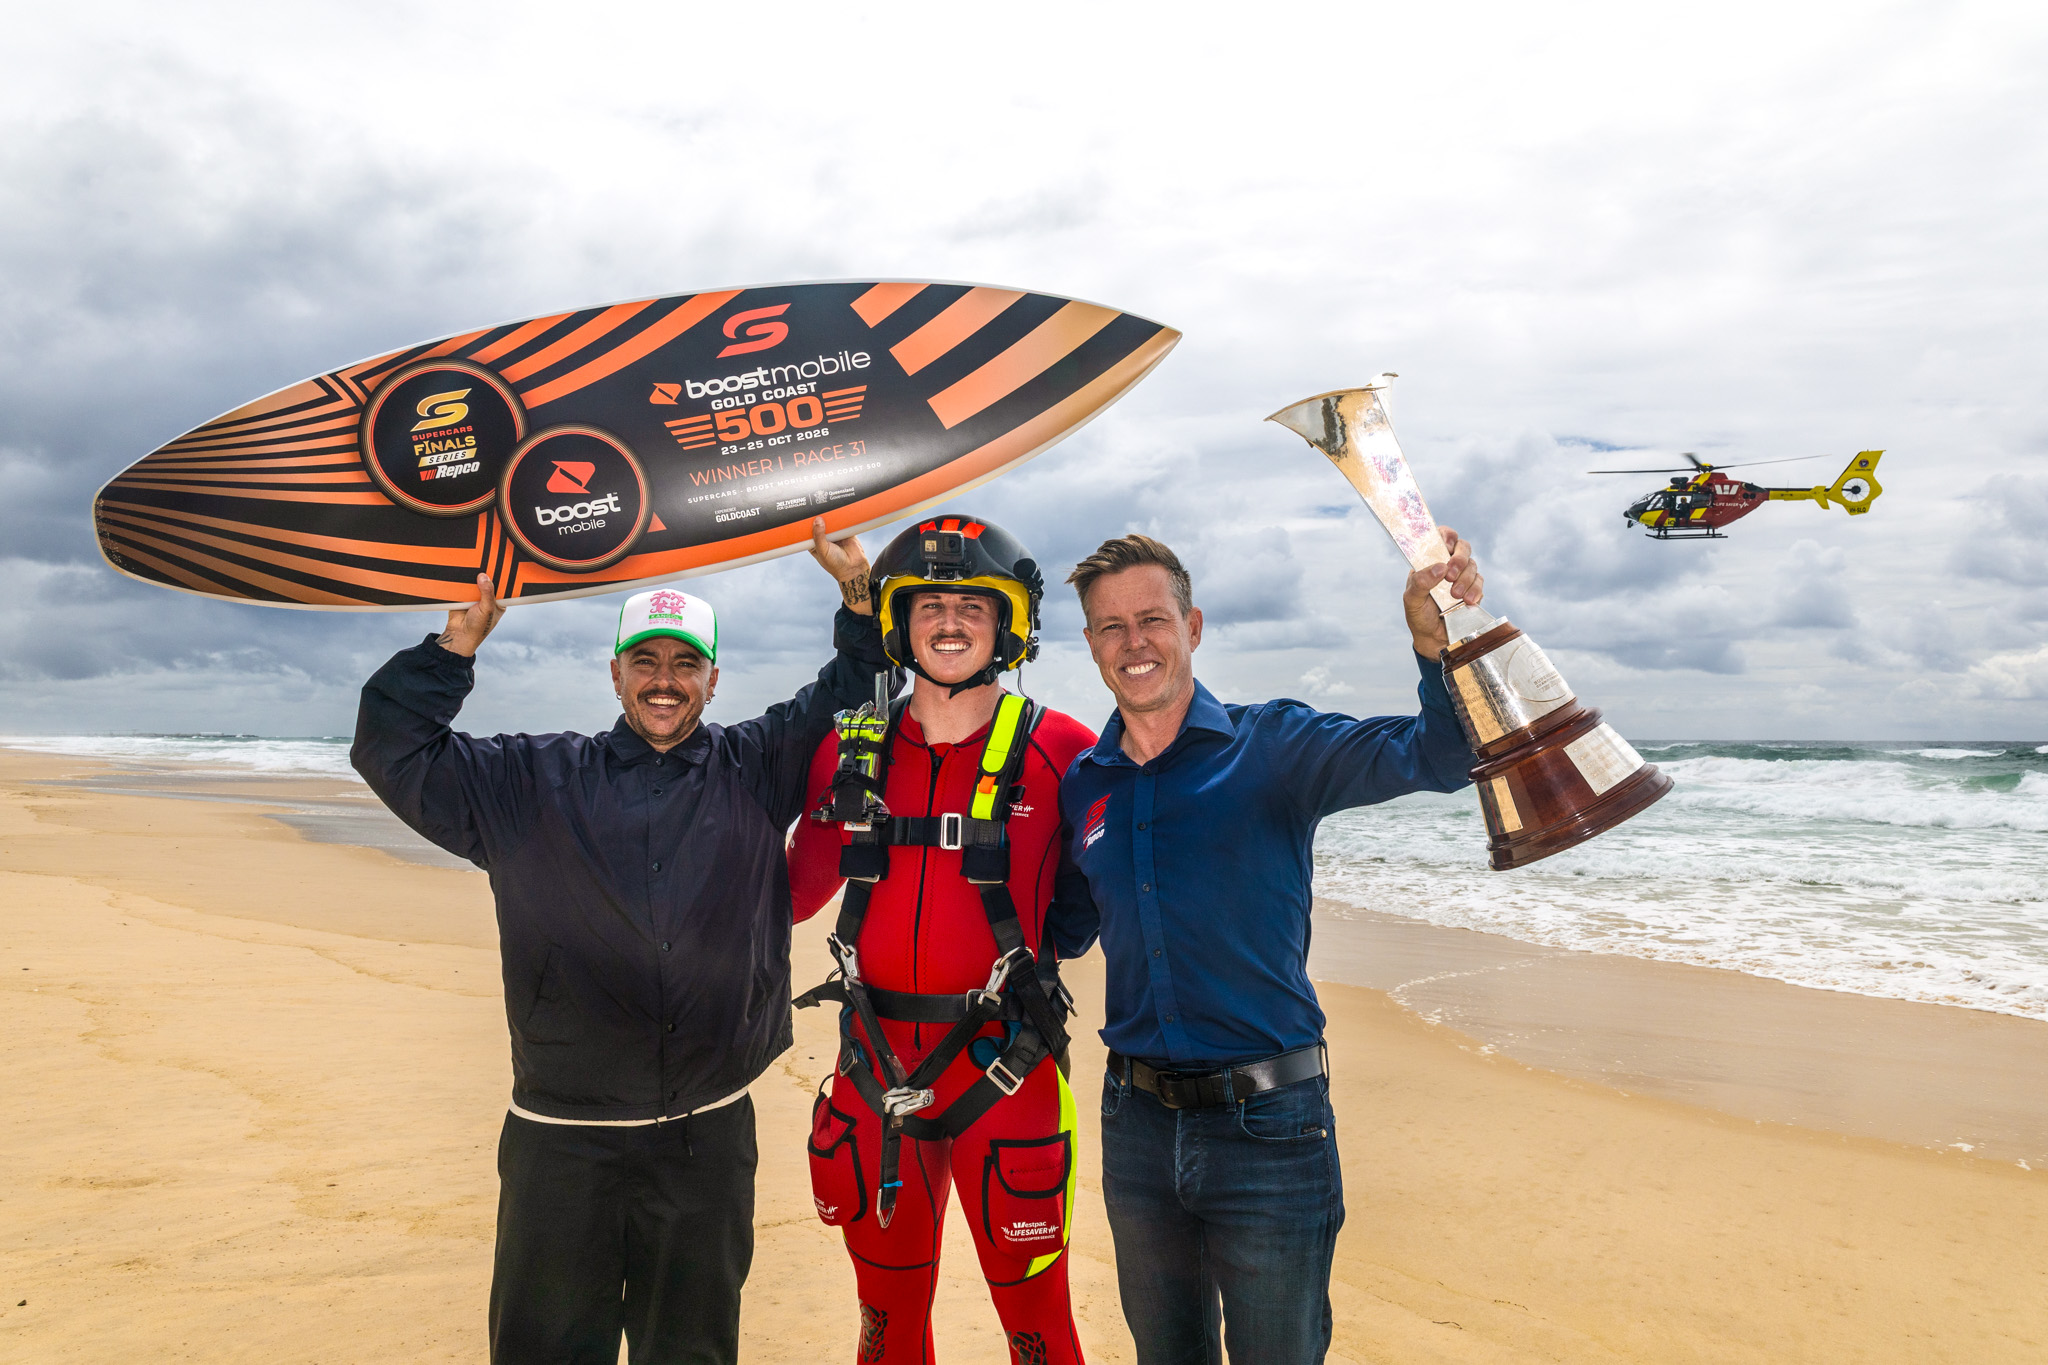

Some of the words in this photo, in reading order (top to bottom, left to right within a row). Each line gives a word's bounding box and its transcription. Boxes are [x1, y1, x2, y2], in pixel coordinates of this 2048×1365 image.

[710, 393, 757, 411] GOLD
[762, 381, 817, 401] COAST
[714, 395, 824, 442] 500
[411, 425, 473, 441] SUPERCARS
[768, 434, 792, 447] OCT
[796, 427, 830, 441] 2026
[413, 435, 476, 456] FINALS
[428, 451, 467, 464] SERIES
[689, 458, 774, 487] WINNER
[793, 444, 846, 468] RACE
[848, 440, 867, 457] 31
[435, 461, 480, 479] Repco
[687, 489, 737, 504] SUPERCARS
[746, 482, 774, 493] BOOST
[837, 465, 865, 475] COAST
[866, 461, 882, 470] 500
[535, 492, 621, 526] boost
[715, 507, 761, 523] GOLDCOAST
[558, 519, 606, 536] mobile
[1010, 1227, 1048, 1237] LIFESAVER
[1012, 1221, 1047, 1229] Westpac
